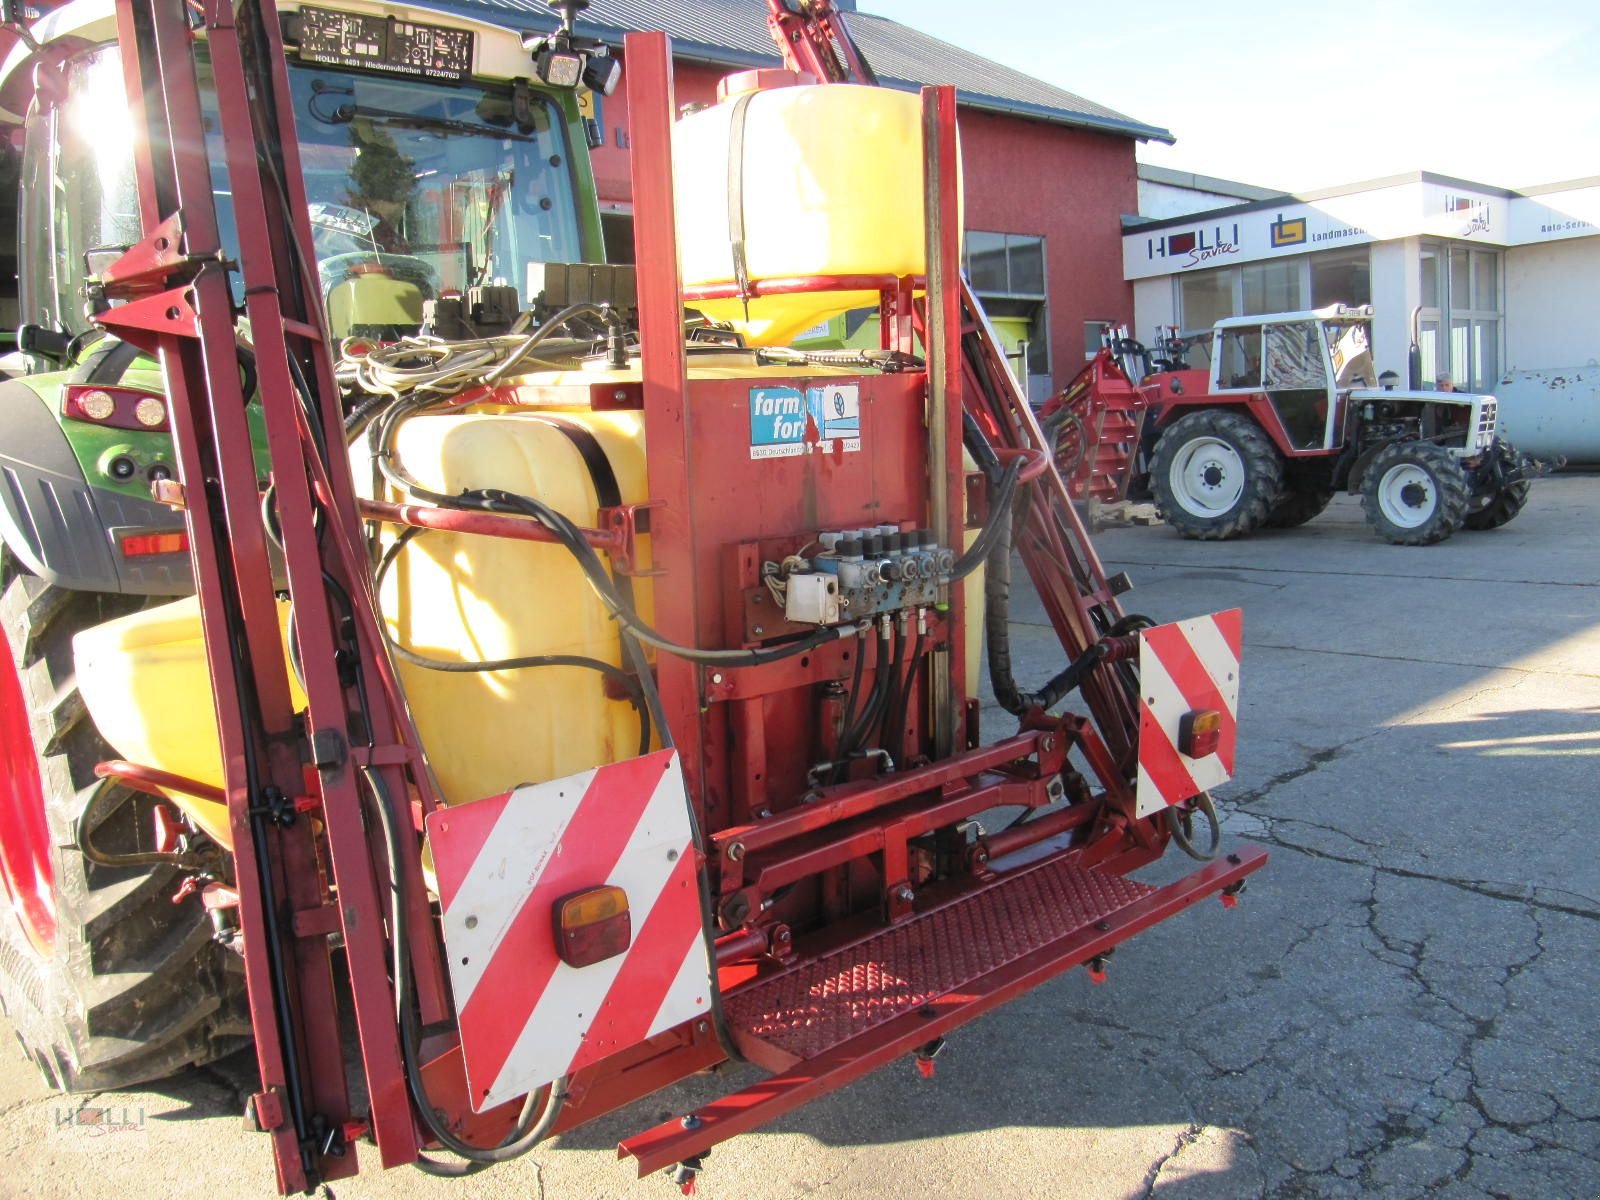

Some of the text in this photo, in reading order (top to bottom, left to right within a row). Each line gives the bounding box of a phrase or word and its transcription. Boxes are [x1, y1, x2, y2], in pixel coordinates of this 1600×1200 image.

[315, 54, 339, 64] HOLLI
[1148, 224, 1238, 260] HOLLI
[1182, 242, 1240, 268] Service
[754, 392, 800, 415] farm
